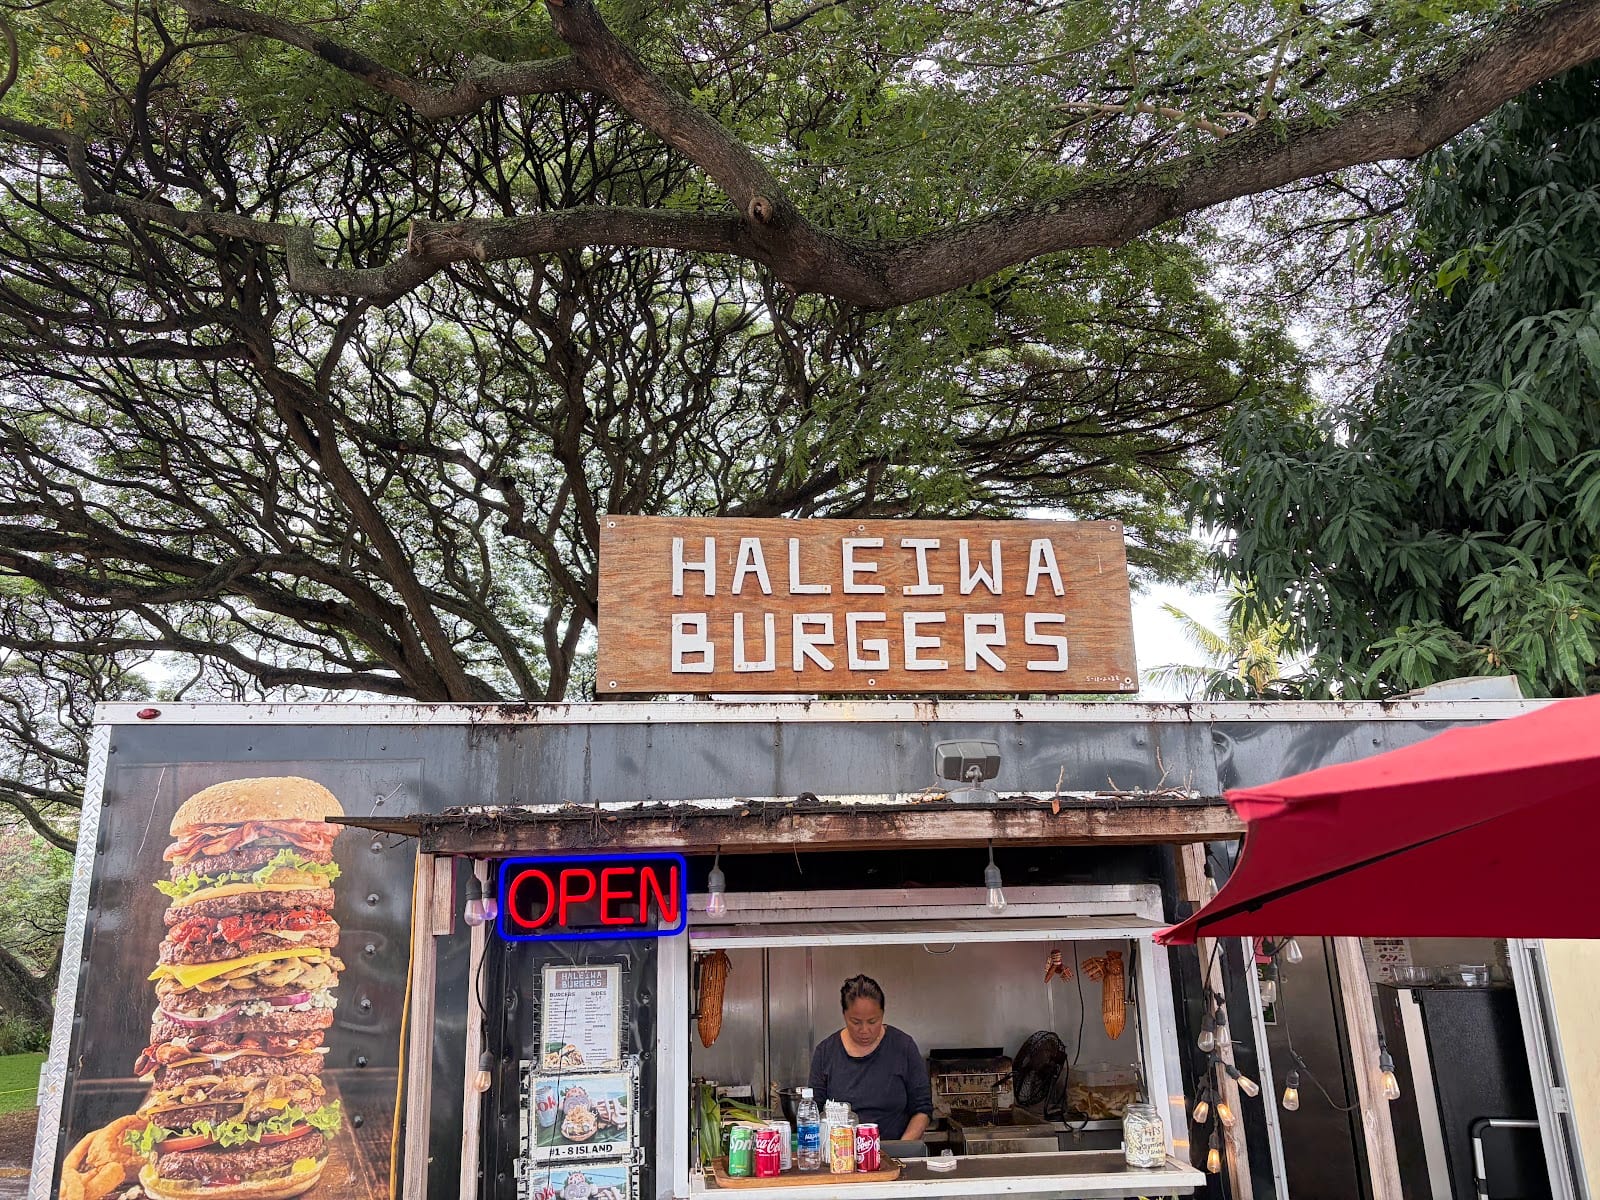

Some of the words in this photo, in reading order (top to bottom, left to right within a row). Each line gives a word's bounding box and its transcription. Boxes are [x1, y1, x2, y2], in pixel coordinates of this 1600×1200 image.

[671, 536, 1065, 597] HALEIWA
[671, 611, 1069, 674] BURGERS
[508, 865, 678, 929] OPEN
[561, 971, 602, 979] HALEIWA
[561, 980, 602, 989] BURGERS
[567, 1147, 574, 1155] 8
[576, 1144, 613, 1155] ISLAND
